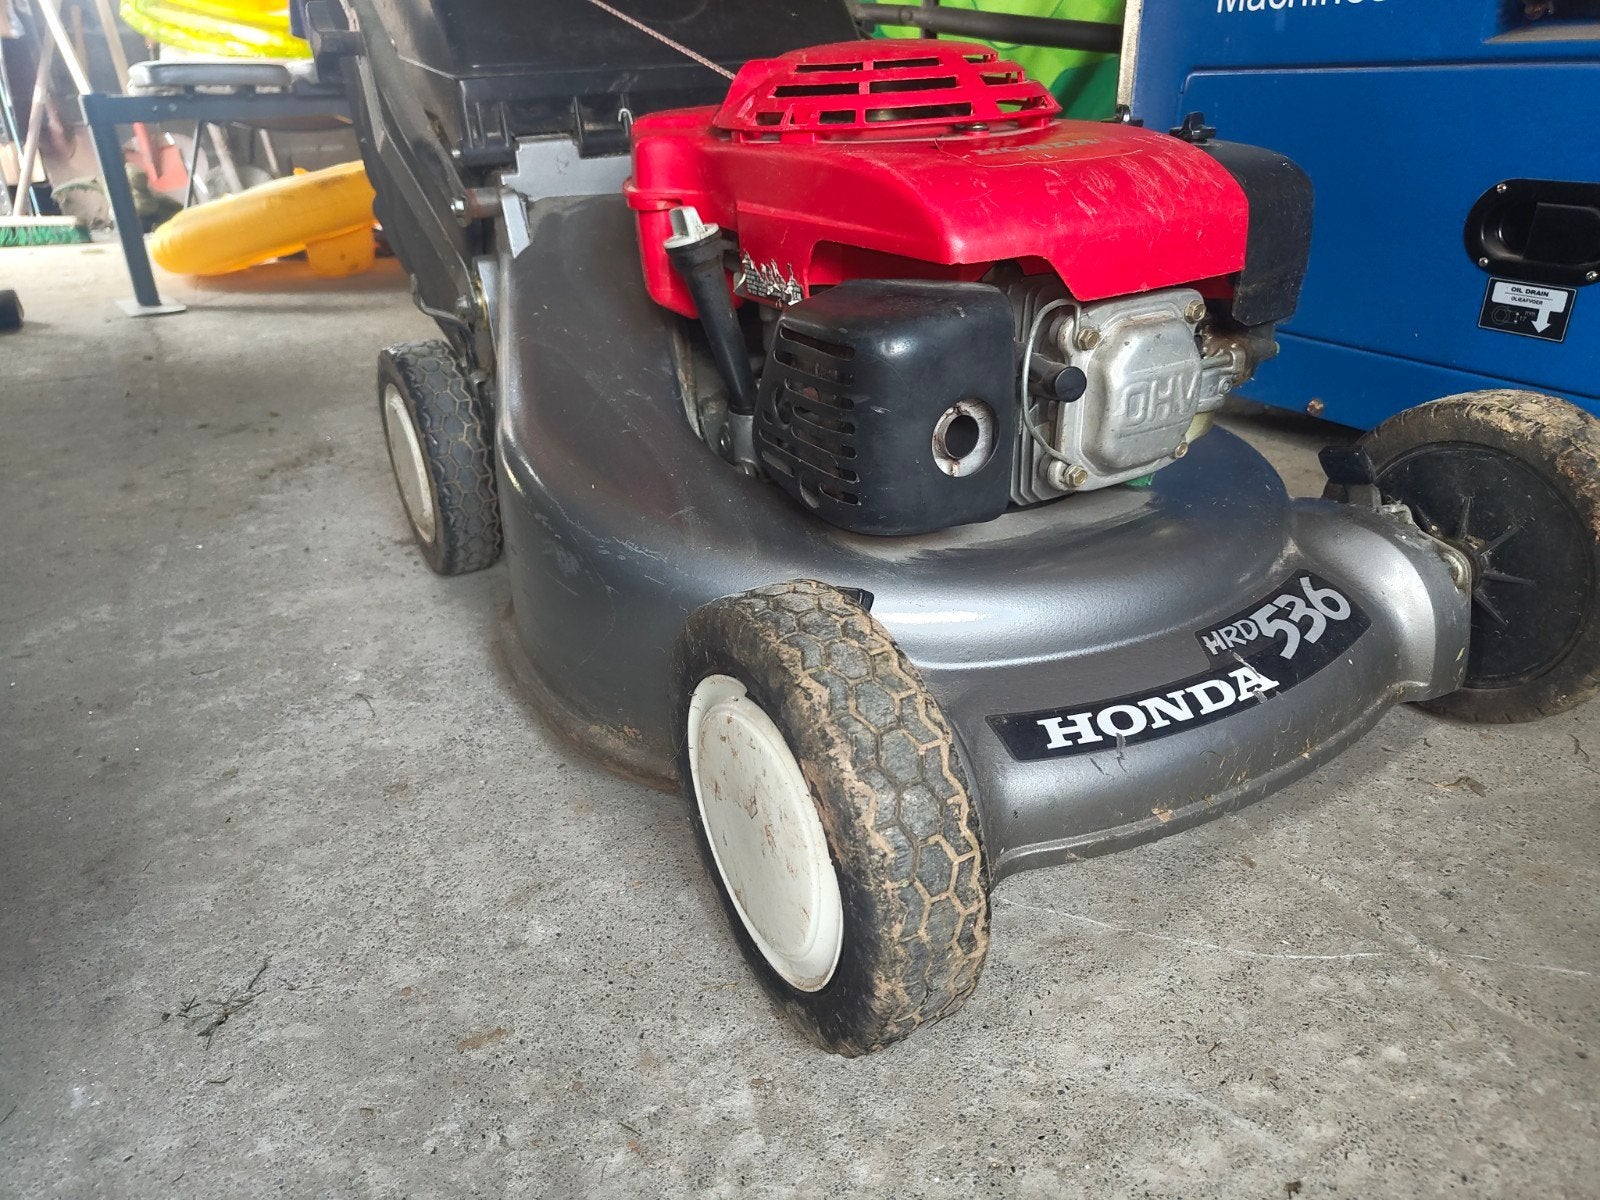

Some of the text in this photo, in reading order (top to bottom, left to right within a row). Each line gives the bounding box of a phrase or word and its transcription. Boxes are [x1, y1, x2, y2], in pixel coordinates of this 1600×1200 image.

[1525, 288, 1549, 297] DRAIN
[1119, 371, 1199, 425] OHV
[1036, 667, 1280, 750] HONDA
